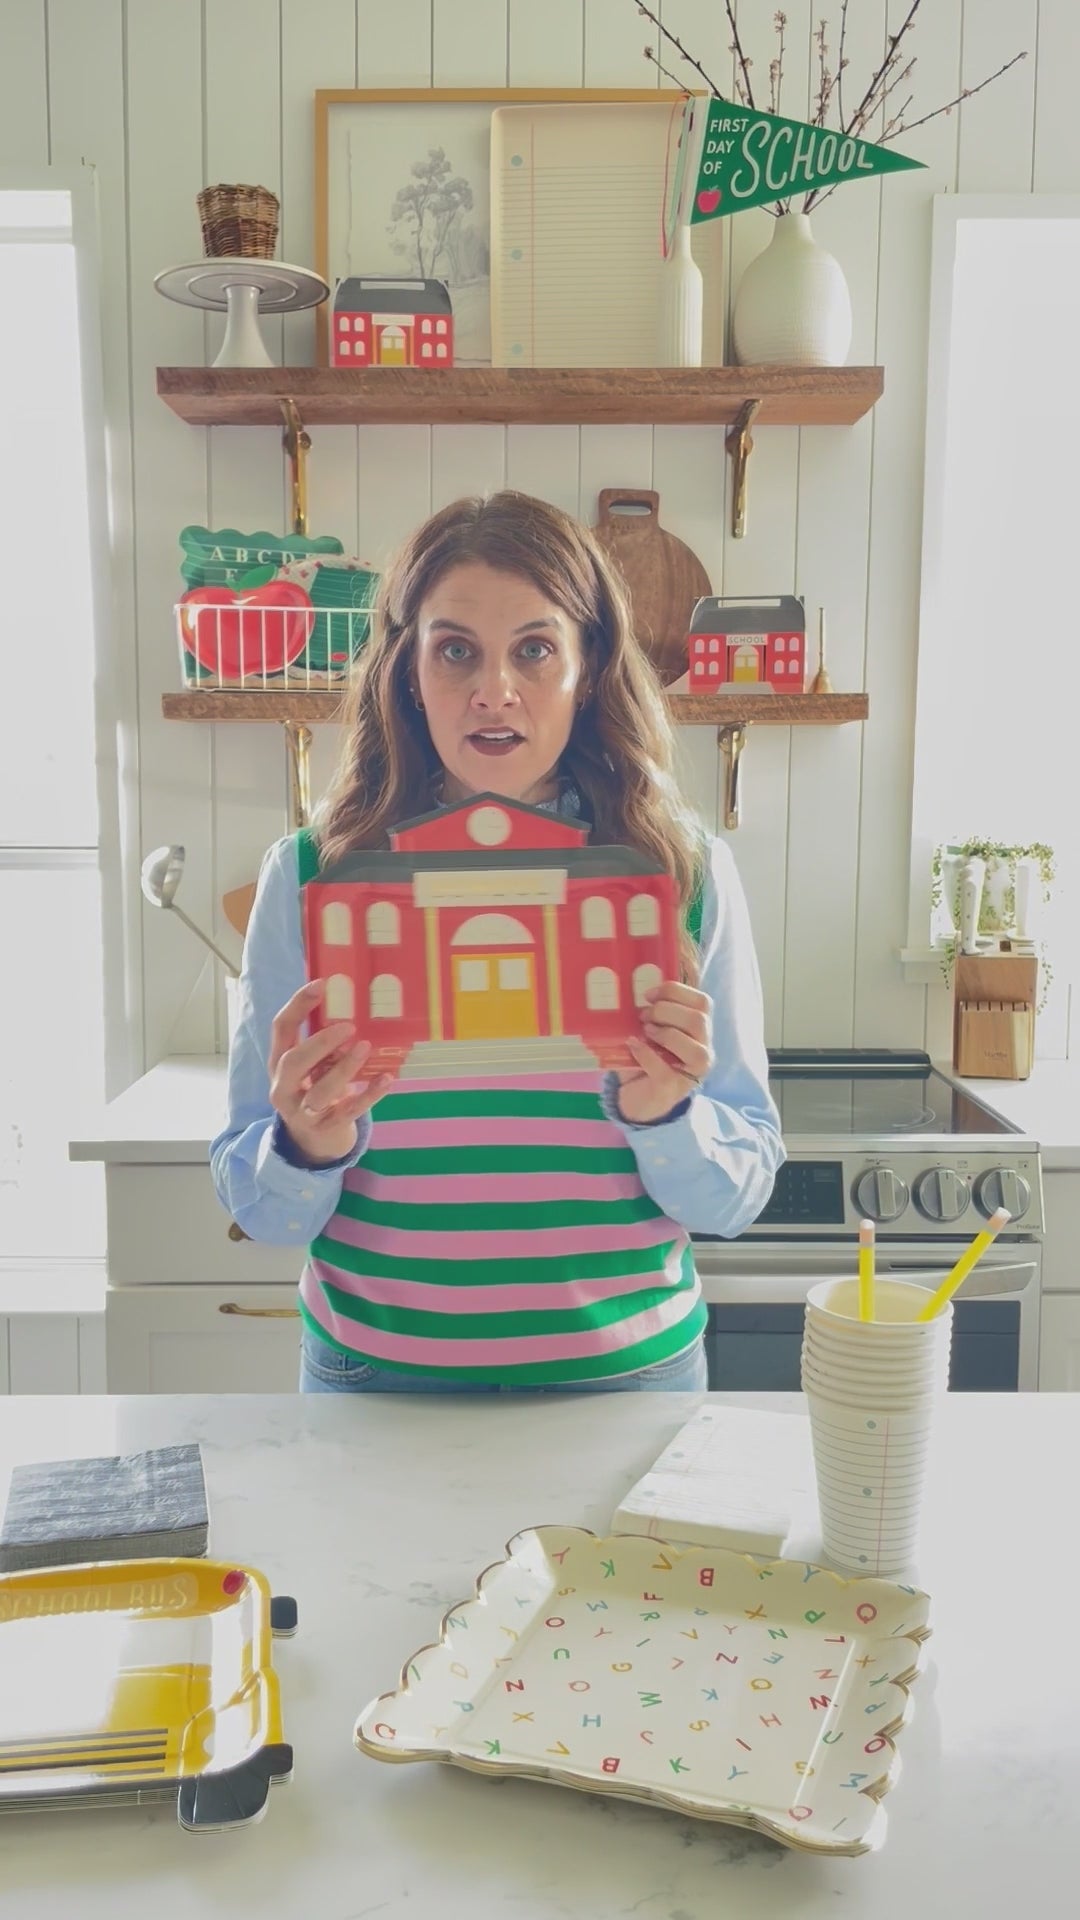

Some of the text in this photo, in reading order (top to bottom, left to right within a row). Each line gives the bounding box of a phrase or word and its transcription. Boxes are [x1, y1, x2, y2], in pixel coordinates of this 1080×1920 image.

[710, 118, 749, 133] FIRST
[706, 140, 735, 154] DAY
[730, 120, 874, 198] SCHOOL
[703, 161, 723, 175] OF
[728, 636, 765, 644] SCHOOL
[699, 1568, 714, 1586] B
[129, 1577, 188, 1612] BUS
[856, 1603, 877, 1624] Q
[545, 1617, 565, 1628] O
[512, 1712, 535, 1723] X
[864, 1737, 886, 1754] O
[602, 1757, 621, 1774] B
[669, 1757, 691, 1774] K
[727, 1765, 750, 1781] Y
